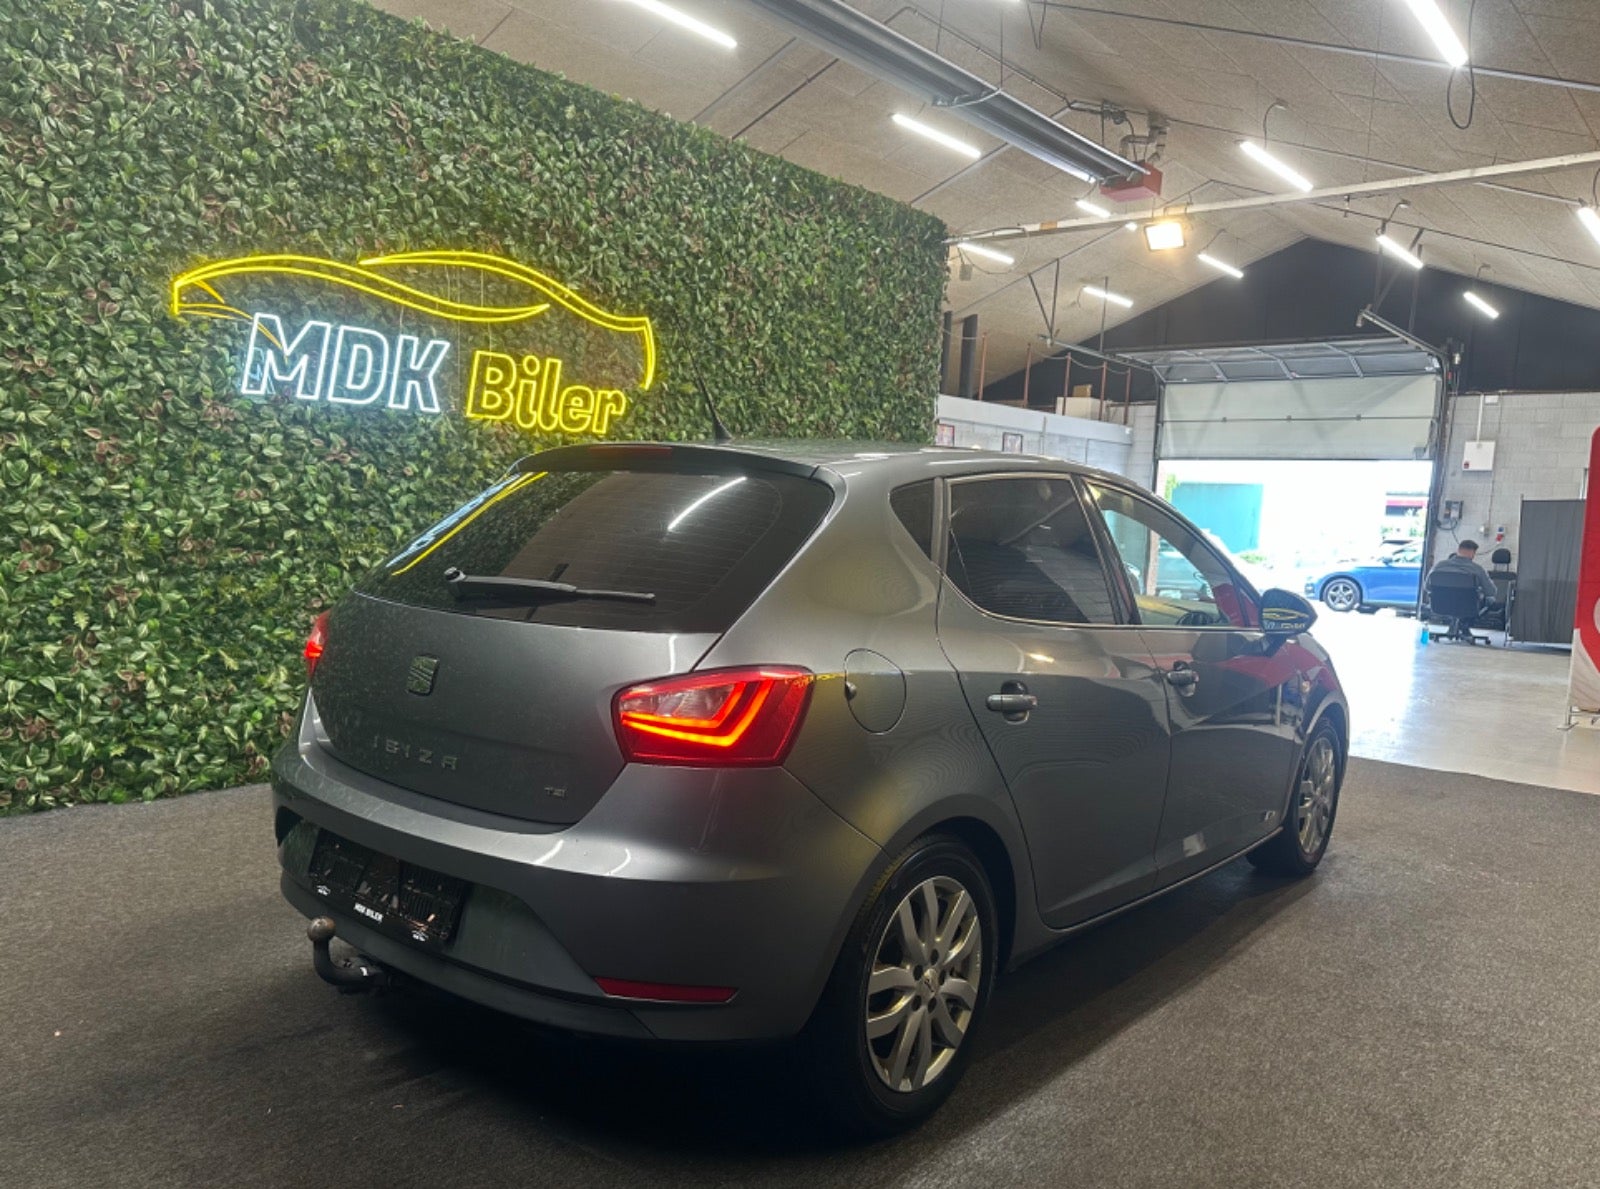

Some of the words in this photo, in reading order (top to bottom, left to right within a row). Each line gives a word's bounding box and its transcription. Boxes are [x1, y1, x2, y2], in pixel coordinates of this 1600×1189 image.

[241, 312, 449, 413] MDK
[466, 349, 627, 435] Biler
[373, 735, 459, 770] IBIZA
